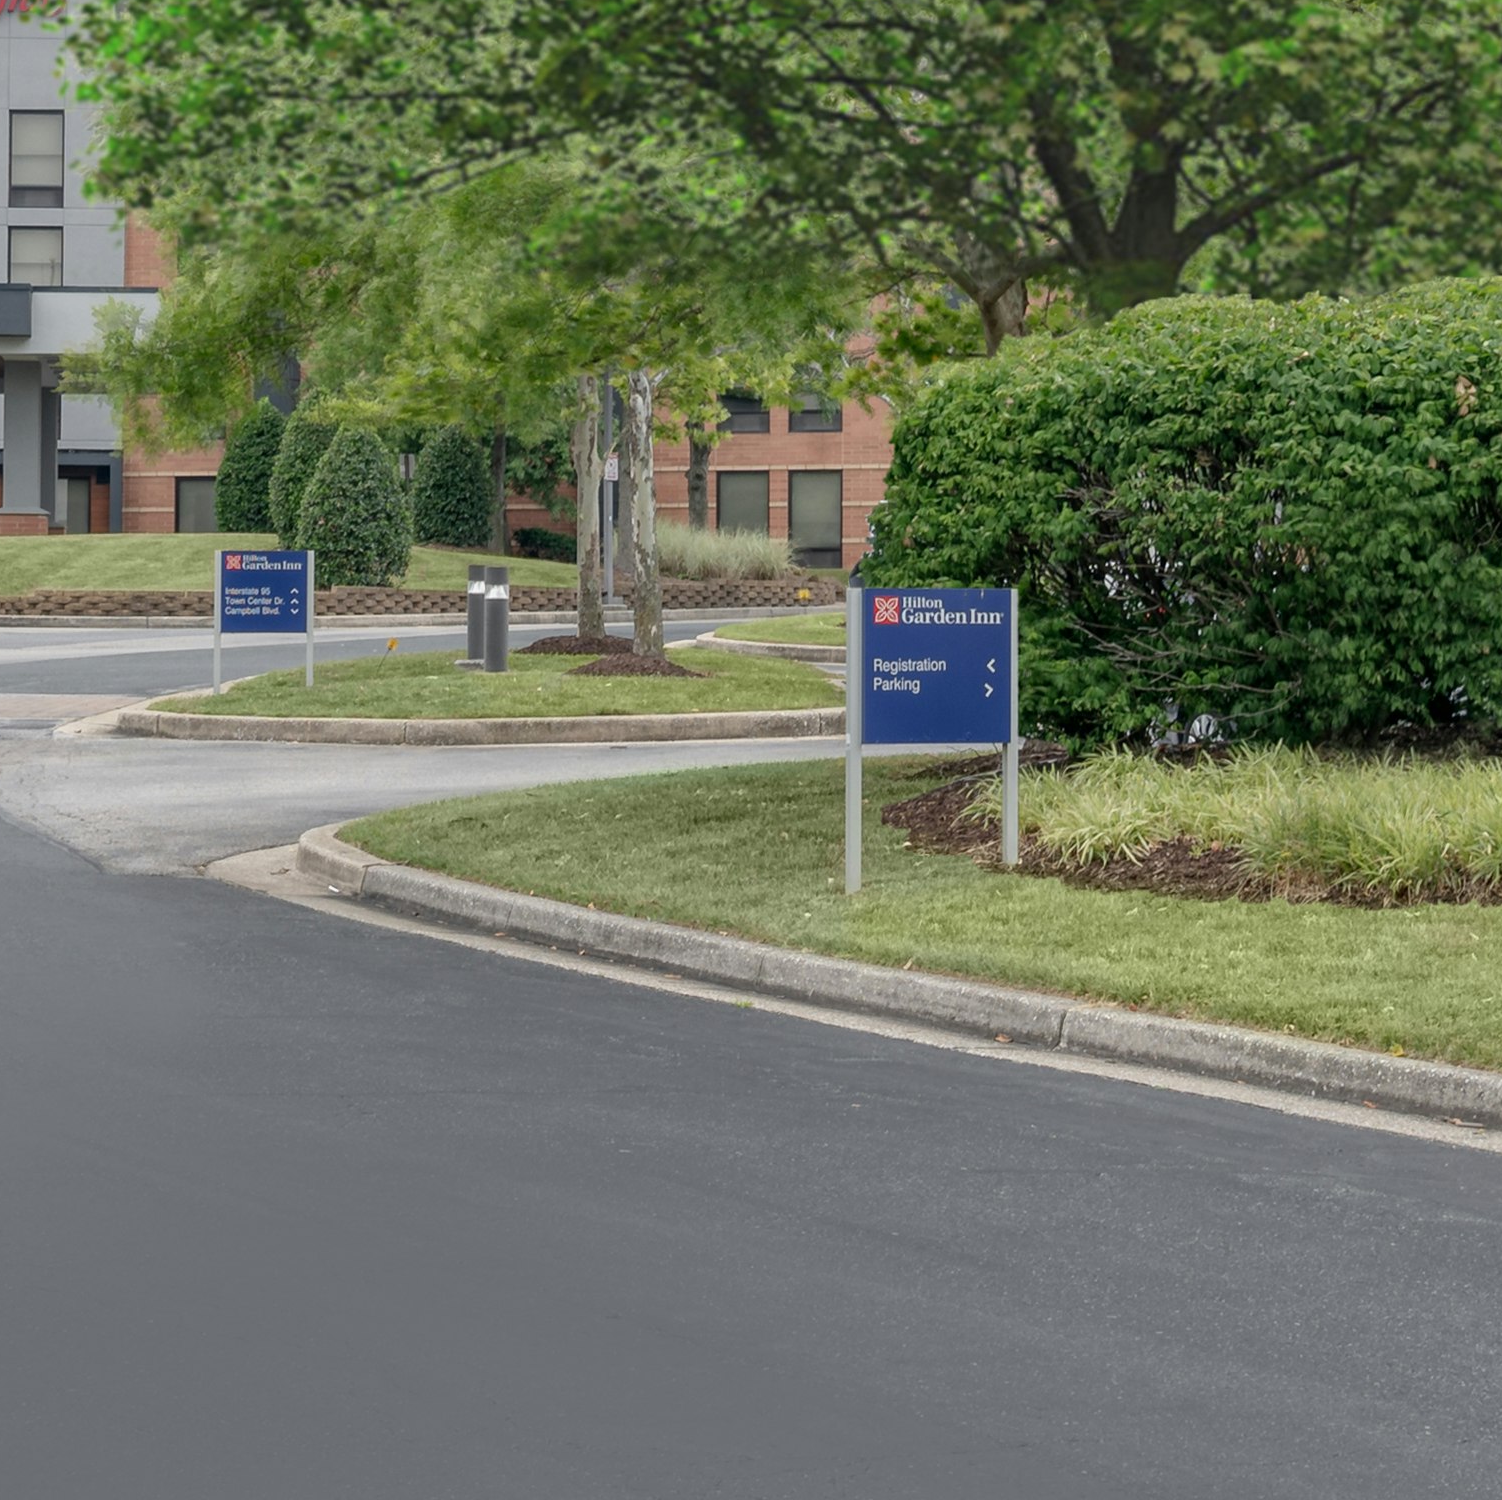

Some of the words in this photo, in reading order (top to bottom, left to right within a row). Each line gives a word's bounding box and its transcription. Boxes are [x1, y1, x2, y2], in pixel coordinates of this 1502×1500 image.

[242, 561, 282, 570] Garden
[282, 561, 302, 570] Inn
[225, 587, 259, 595] Interstate
[225, 597, 245, 605] Town
[247, 597, 272, 605] Center
[274, 597, 285, 605] Dr.
[902, 596, 943, 609] Hilton
[225, 607, 260, 616] Campbell
[262, 607, 280, 615] Blvd.
[901, 608, 968, 625] Garden
[970, 608, 1002, 625] Inn
[873, 658, 947, 675] Registration
[873, 677, 921, 694] Parking
